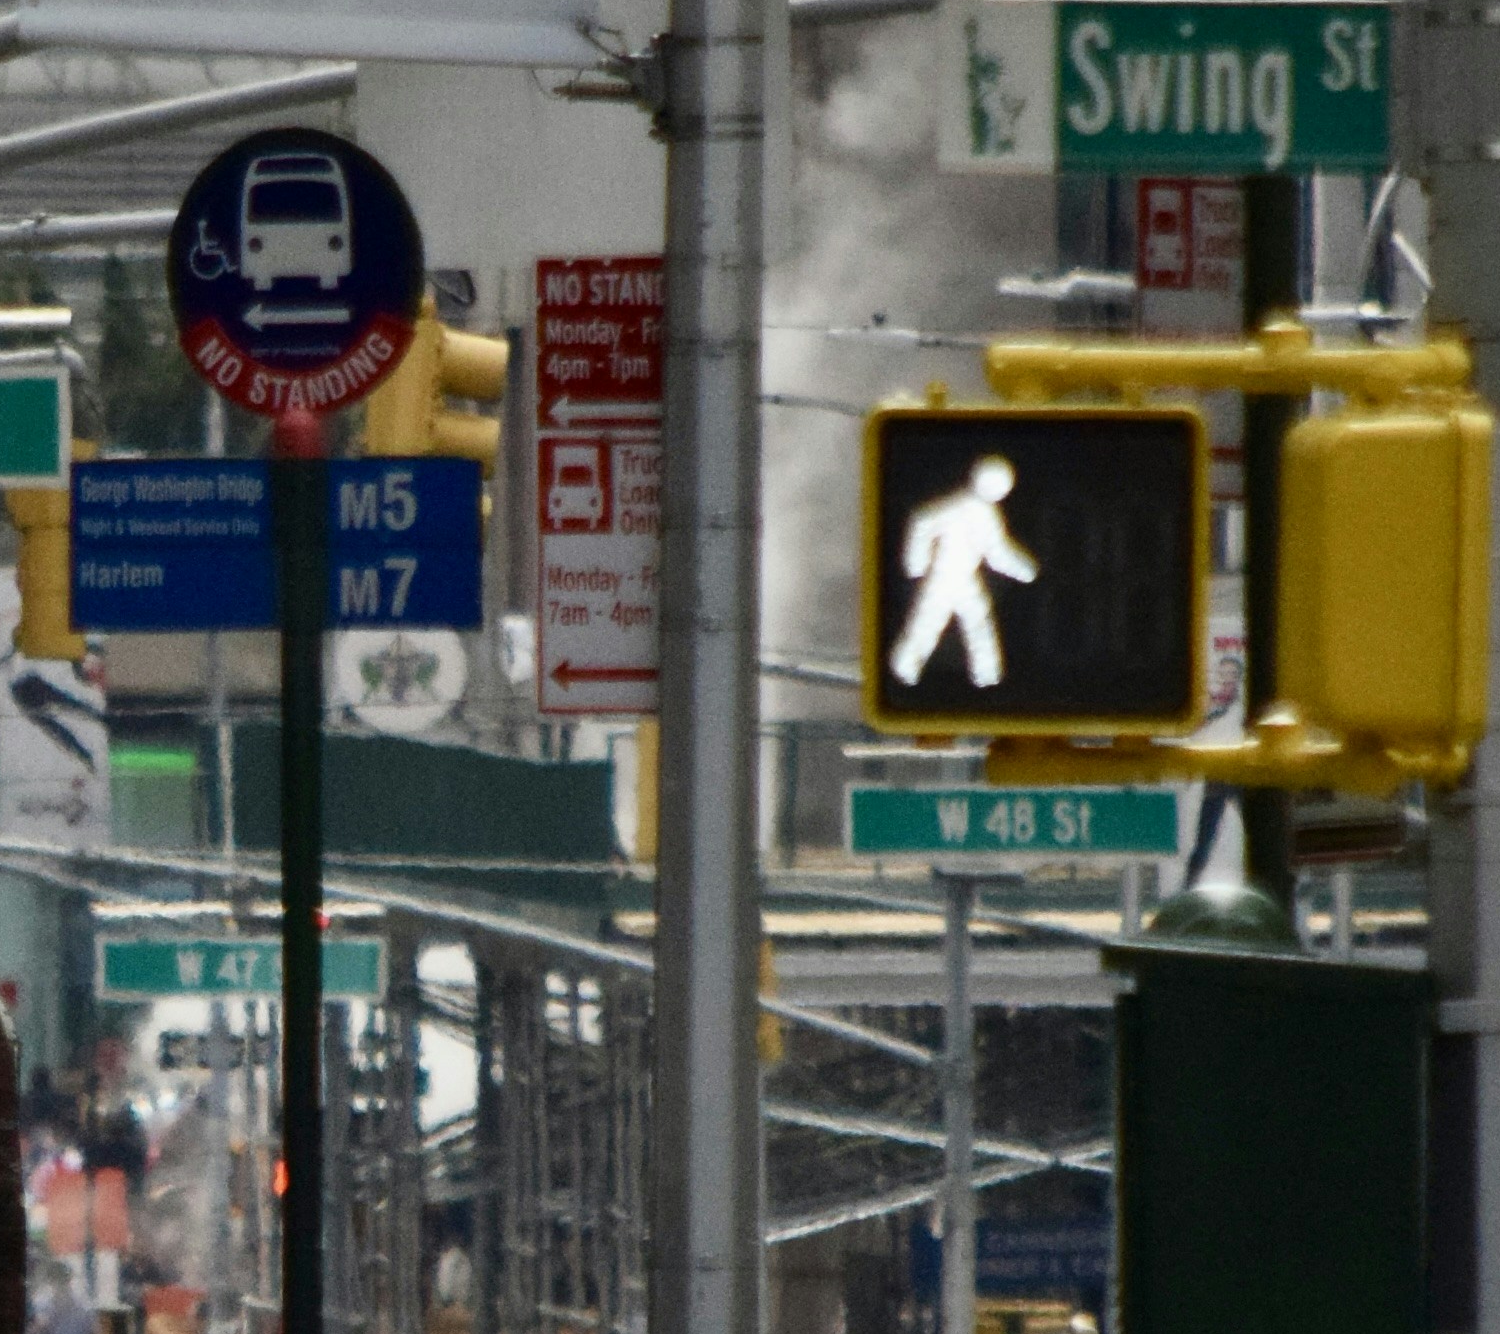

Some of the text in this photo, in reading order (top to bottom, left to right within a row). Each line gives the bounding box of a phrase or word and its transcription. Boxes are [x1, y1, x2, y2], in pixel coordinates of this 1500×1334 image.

[1068, 20, 1378, 169] Swing St
[546, 273, 581, 305] NO
[546, 319, 623, 351] Monday
[197, 331, 396, 412] NO STANDING
[547, 353, 590, 384] 4pm
[609, 353, 649, 384] 7pm
[81, 475, 130, 508] George
[133, 473, 214, 507] Washington
[340, 474, 417, 531] M5
[81, 561, 164, 589] Harlem
[340, 557, 417, 618] M7
[548, 566, 622, 595] Monday
[548, 601, 590, 626] 7am
[610, 600, 653, 631] 4pm
[937, 796, 1094, 844] W 48 St
[177, 950, 204, 987] W
[216, 950, 258, 987] 47
